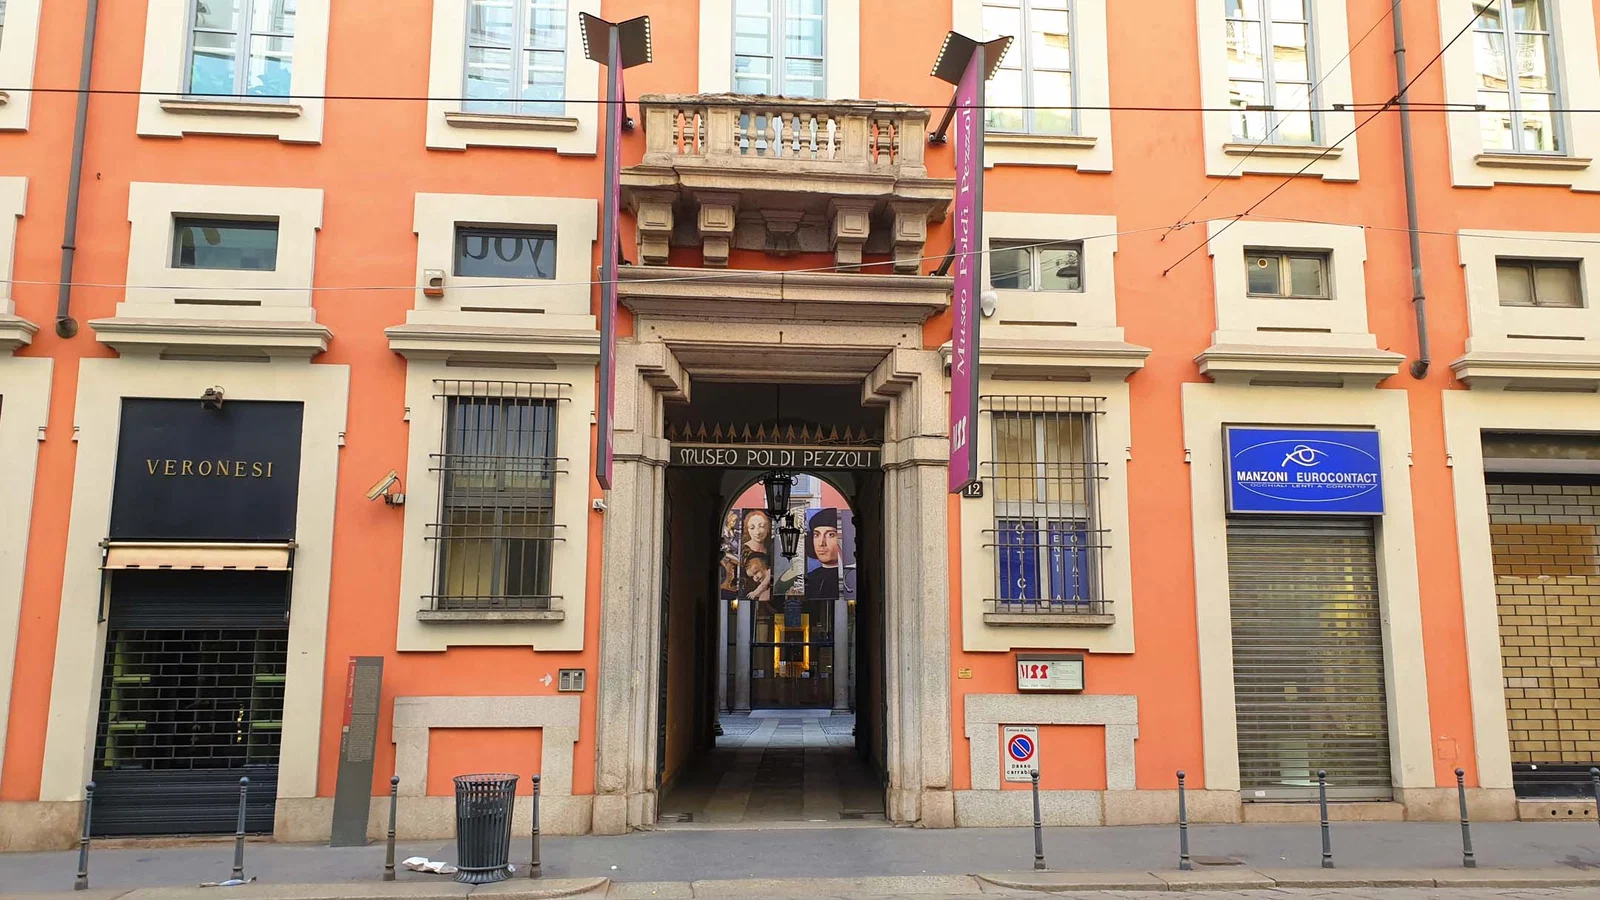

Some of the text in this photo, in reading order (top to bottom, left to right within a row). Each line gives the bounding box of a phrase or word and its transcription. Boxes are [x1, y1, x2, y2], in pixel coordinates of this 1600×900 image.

[957, 97, 971, 376] Museo Poldi Pezzoli
[680, 449, 871, 467] MUSEO POLDI PEZZOLI
[146, 459, 273, 477] VERONESI
[1236, 471, 1378, 483] MANZONI EUROCONTACT
[967, 483, 980, 495] 12
[1015, 524, 1027, 602] OTTICA
